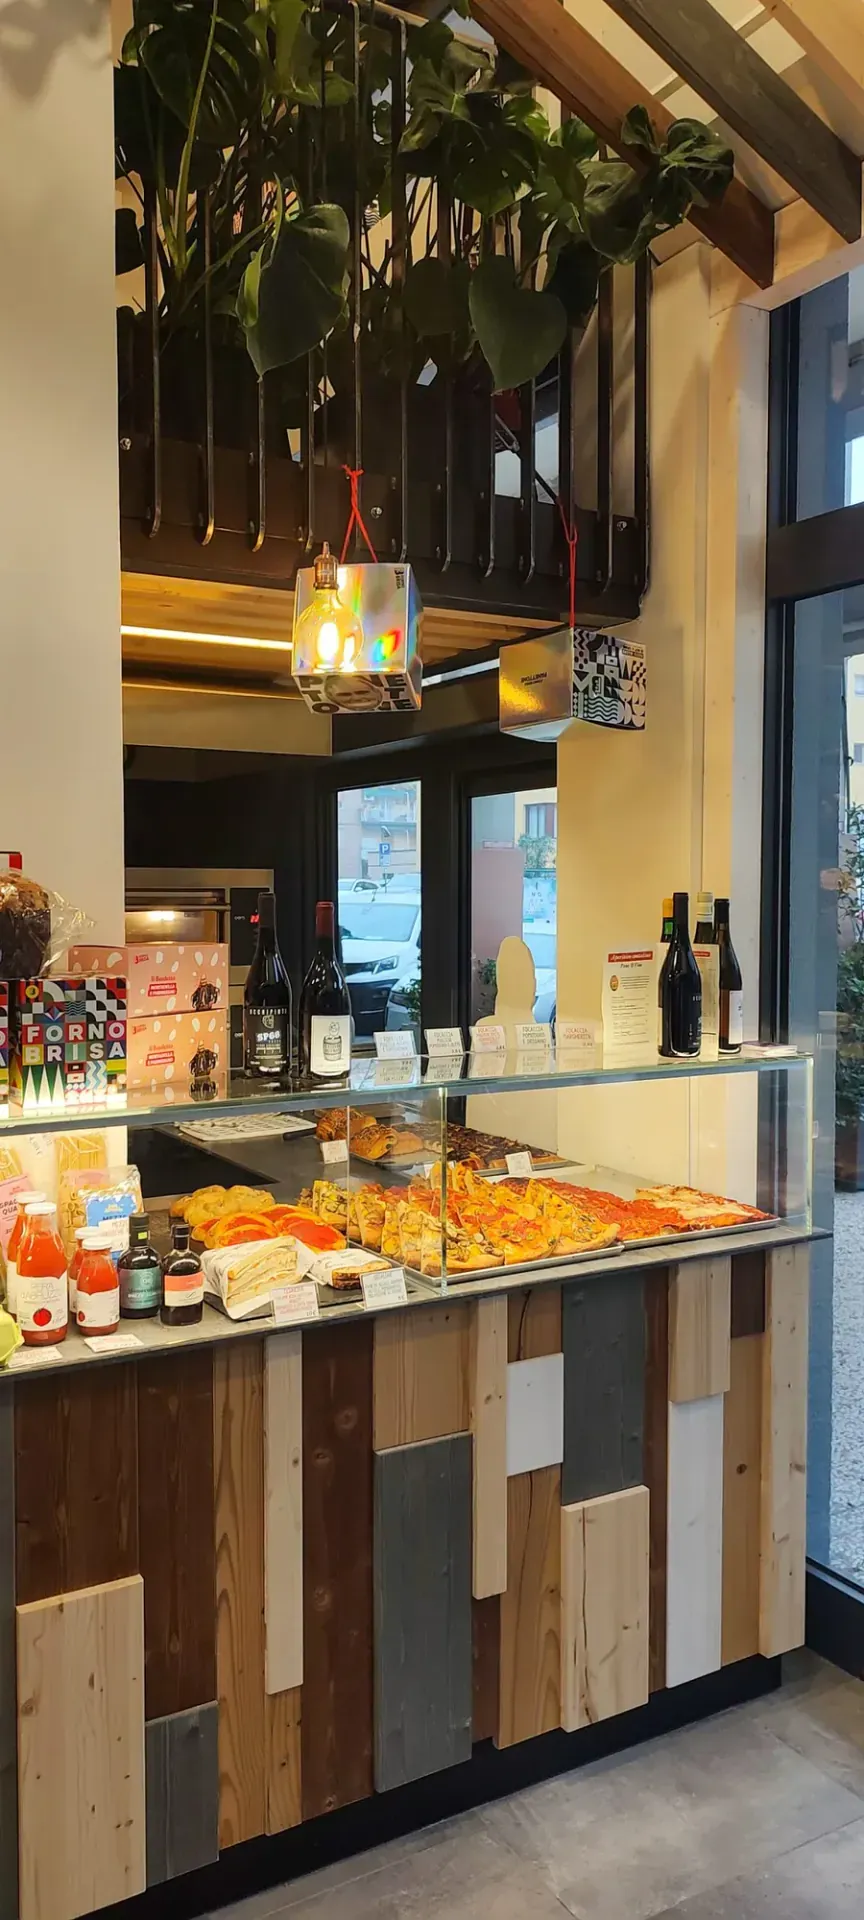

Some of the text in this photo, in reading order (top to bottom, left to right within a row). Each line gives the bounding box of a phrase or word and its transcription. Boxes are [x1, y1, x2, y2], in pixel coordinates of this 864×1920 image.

[382, 845, 389, 854] P
[26, 1021, 126, 1043] FORNO
[25, 1042, 126, 1062] BRISA
